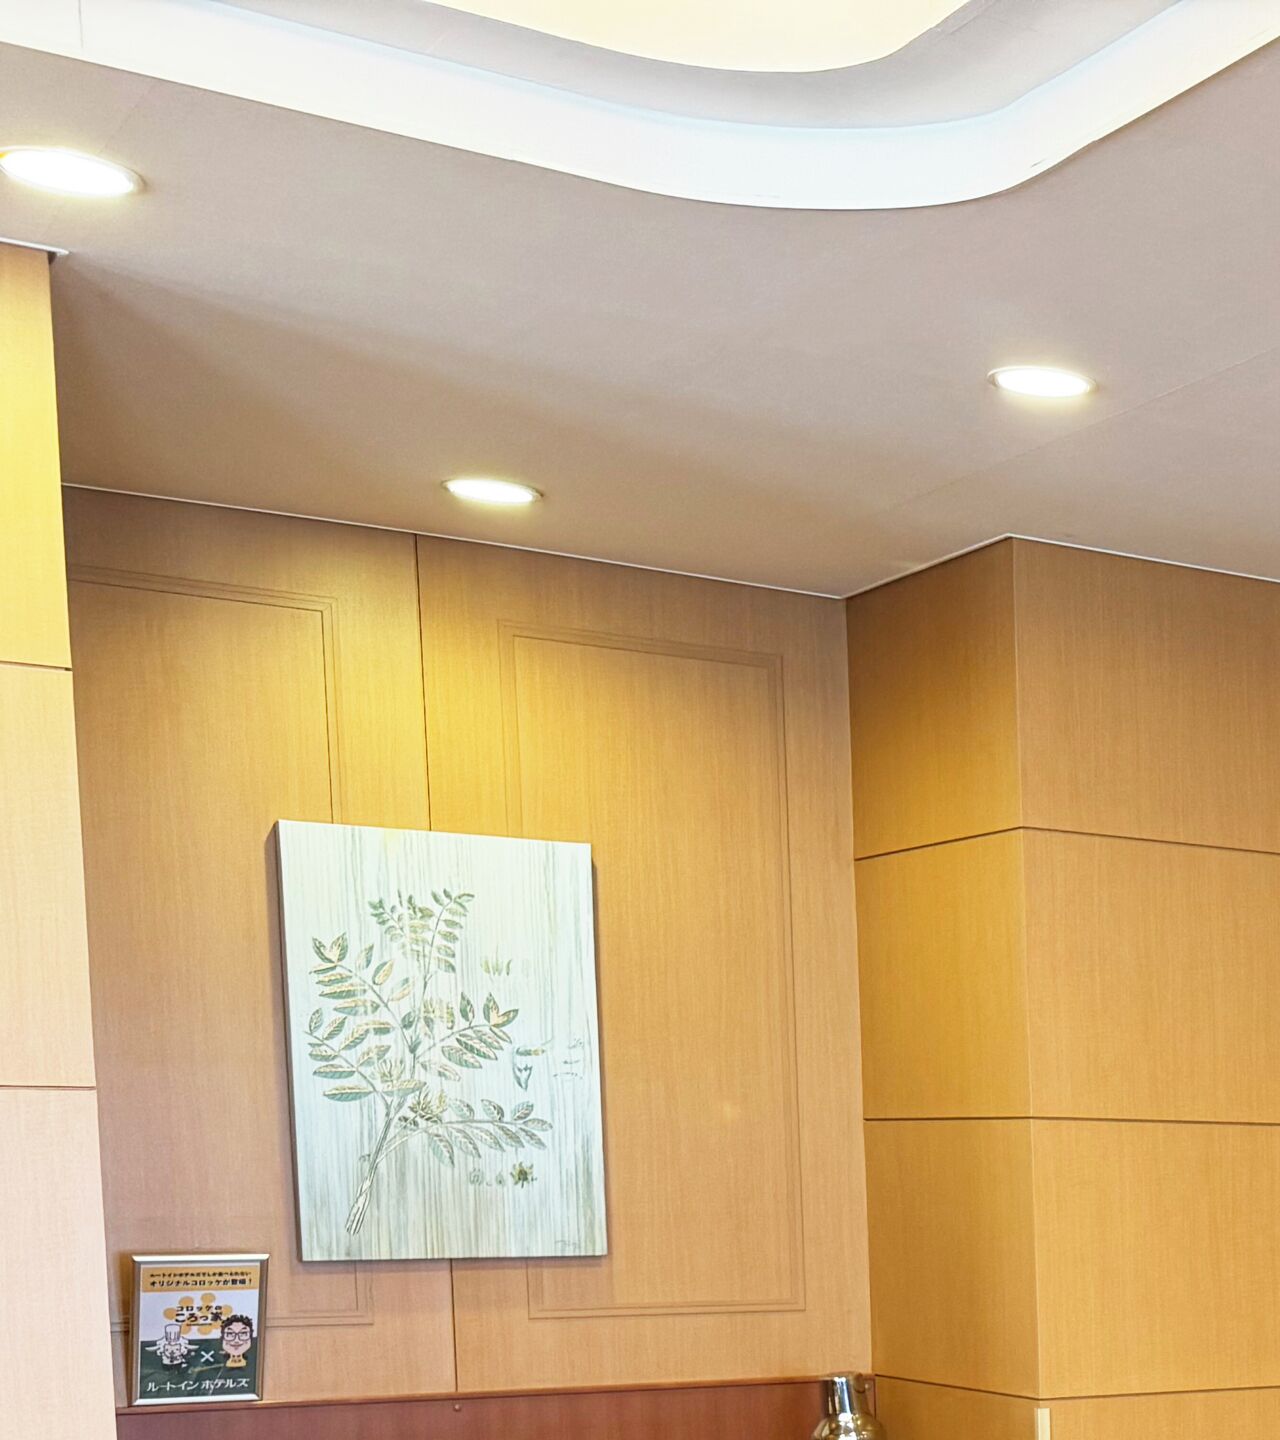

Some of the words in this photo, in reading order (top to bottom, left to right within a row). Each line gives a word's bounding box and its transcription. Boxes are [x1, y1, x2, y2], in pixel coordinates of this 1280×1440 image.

[147, 1381, 199, 1392] ルートイン
[201, 1378, 250, 1390] ホテルズ
